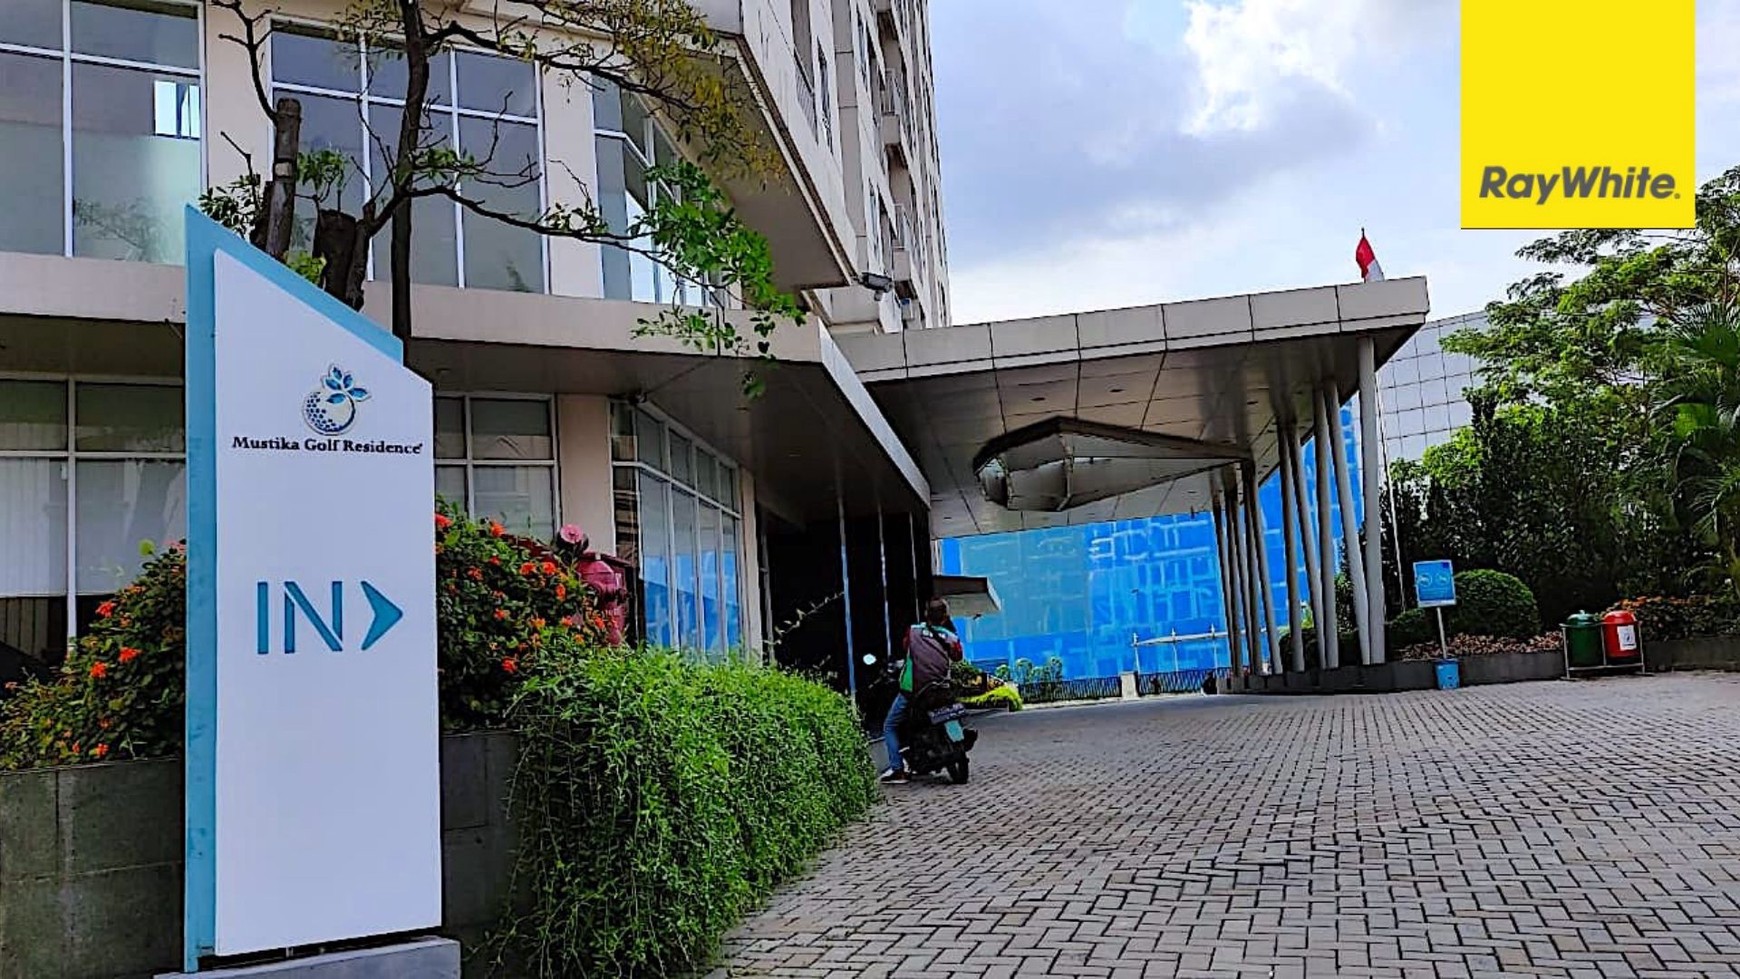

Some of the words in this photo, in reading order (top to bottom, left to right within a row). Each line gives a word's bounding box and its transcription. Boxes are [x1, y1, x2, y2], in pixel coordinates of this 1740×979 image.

[232, 436, 300, 451] Mustika
[304, 438, 341, 452] Golf
[257, 580, 343, 655] IN
